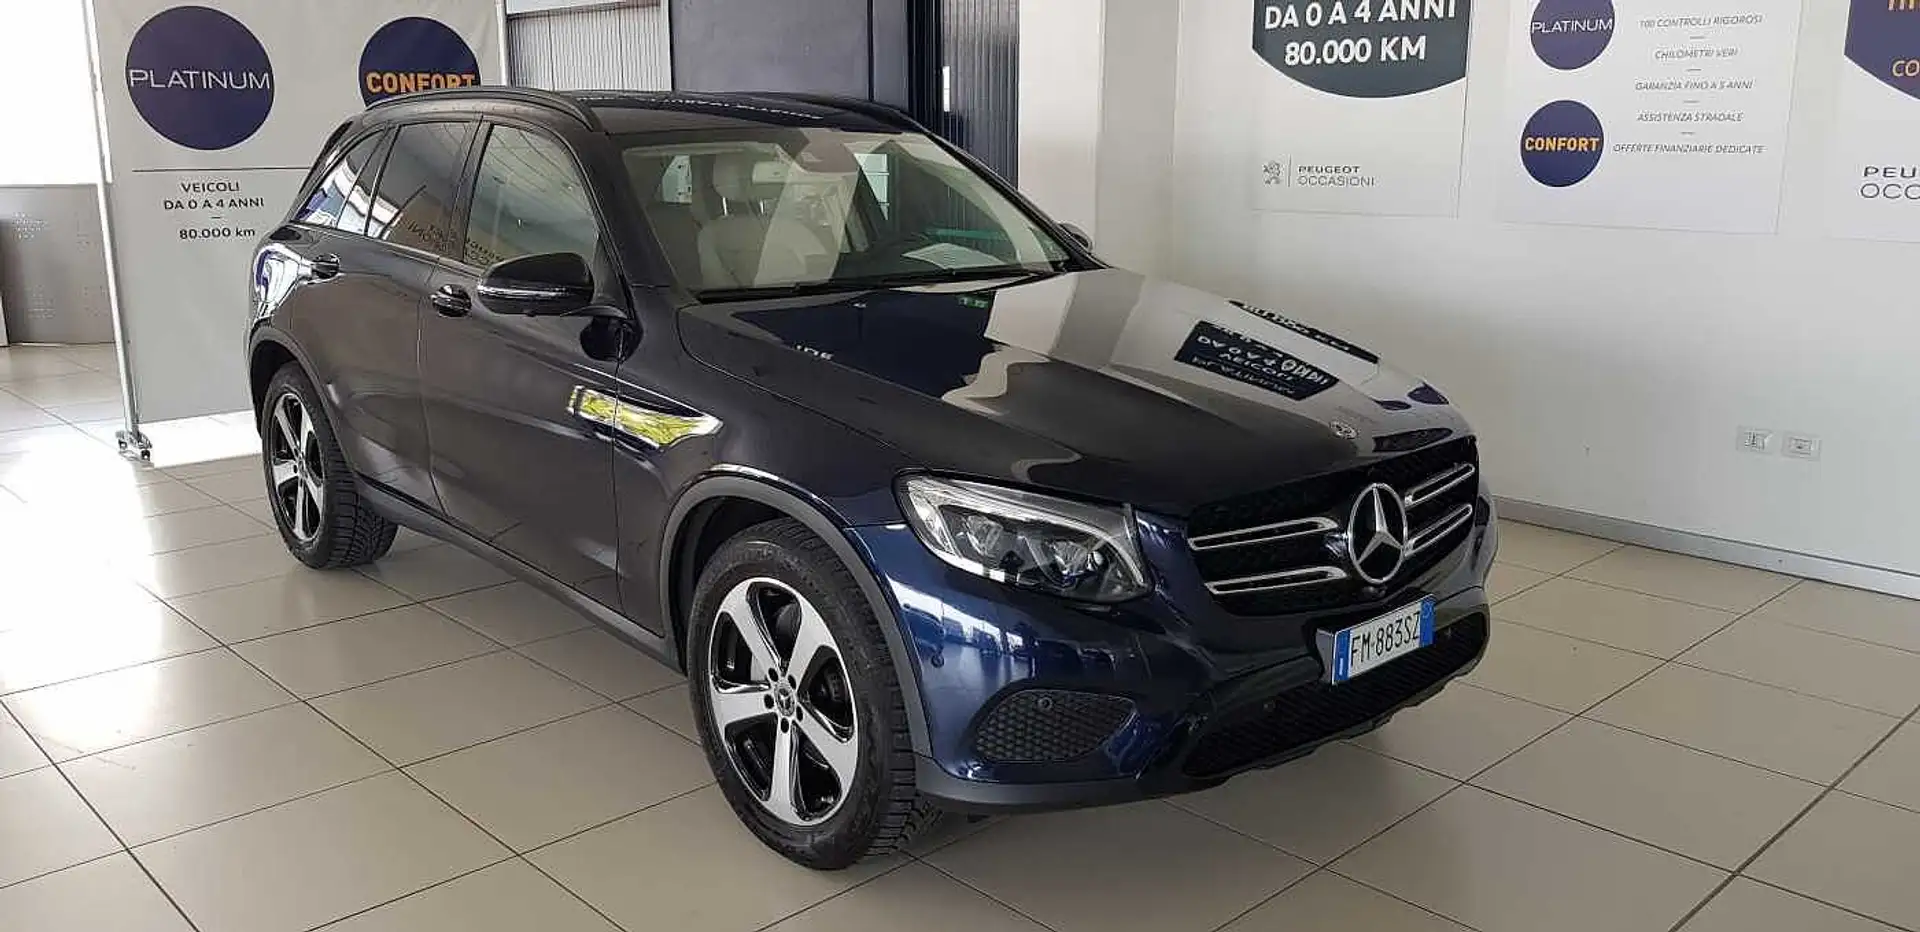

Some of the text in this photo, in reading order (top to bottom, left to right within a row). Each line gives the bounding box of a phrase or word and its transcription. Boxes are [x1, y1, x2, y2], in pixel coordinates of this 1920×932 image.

[1264, 0, 1456, 30] DA 0 A 4 ANNI
[1656, 17, 1712, 28] CONTROLLI
[1712, 14, 1764, 26] RIGOROSI
[1531, 18, 1613, 34] PLATINUM
[1284, 35, 1427, 66] 80.000 KM
[1654, 48, 1739, 60] CHILOMETRI VERI
[129, 69, 271, 89] PLATINUM
[366, 71, 476, 94] CONFORT
[1635, 80, 1683, 91] GARANZIA
[1683, 80, 1709, 90] FINO
[1726, 80, 1753, 90] ANNI
[1637, 112, 1744, 122] ASSISTENZA STRADALE
[1524, 136, 1600, 152] CONFORT
[1613, 143, 1766, 155] OFFERTE FINANZIARIE DEDICATE
[1298, 165, 1361, 174] PEUGEOT
[1863, 165, 1918, 179] PEU
[180, 181, 240, 193] VEICOLI
[1297, 175, 1375, 187] OCCASIONI
[163, 199, 185, 210] DA
[201, 199, 213, 209] A
[215, 198, 225, 208] 4
[228, 197, 265, 208] ANNI
[179, 227, 256, 240] 80.000 km
